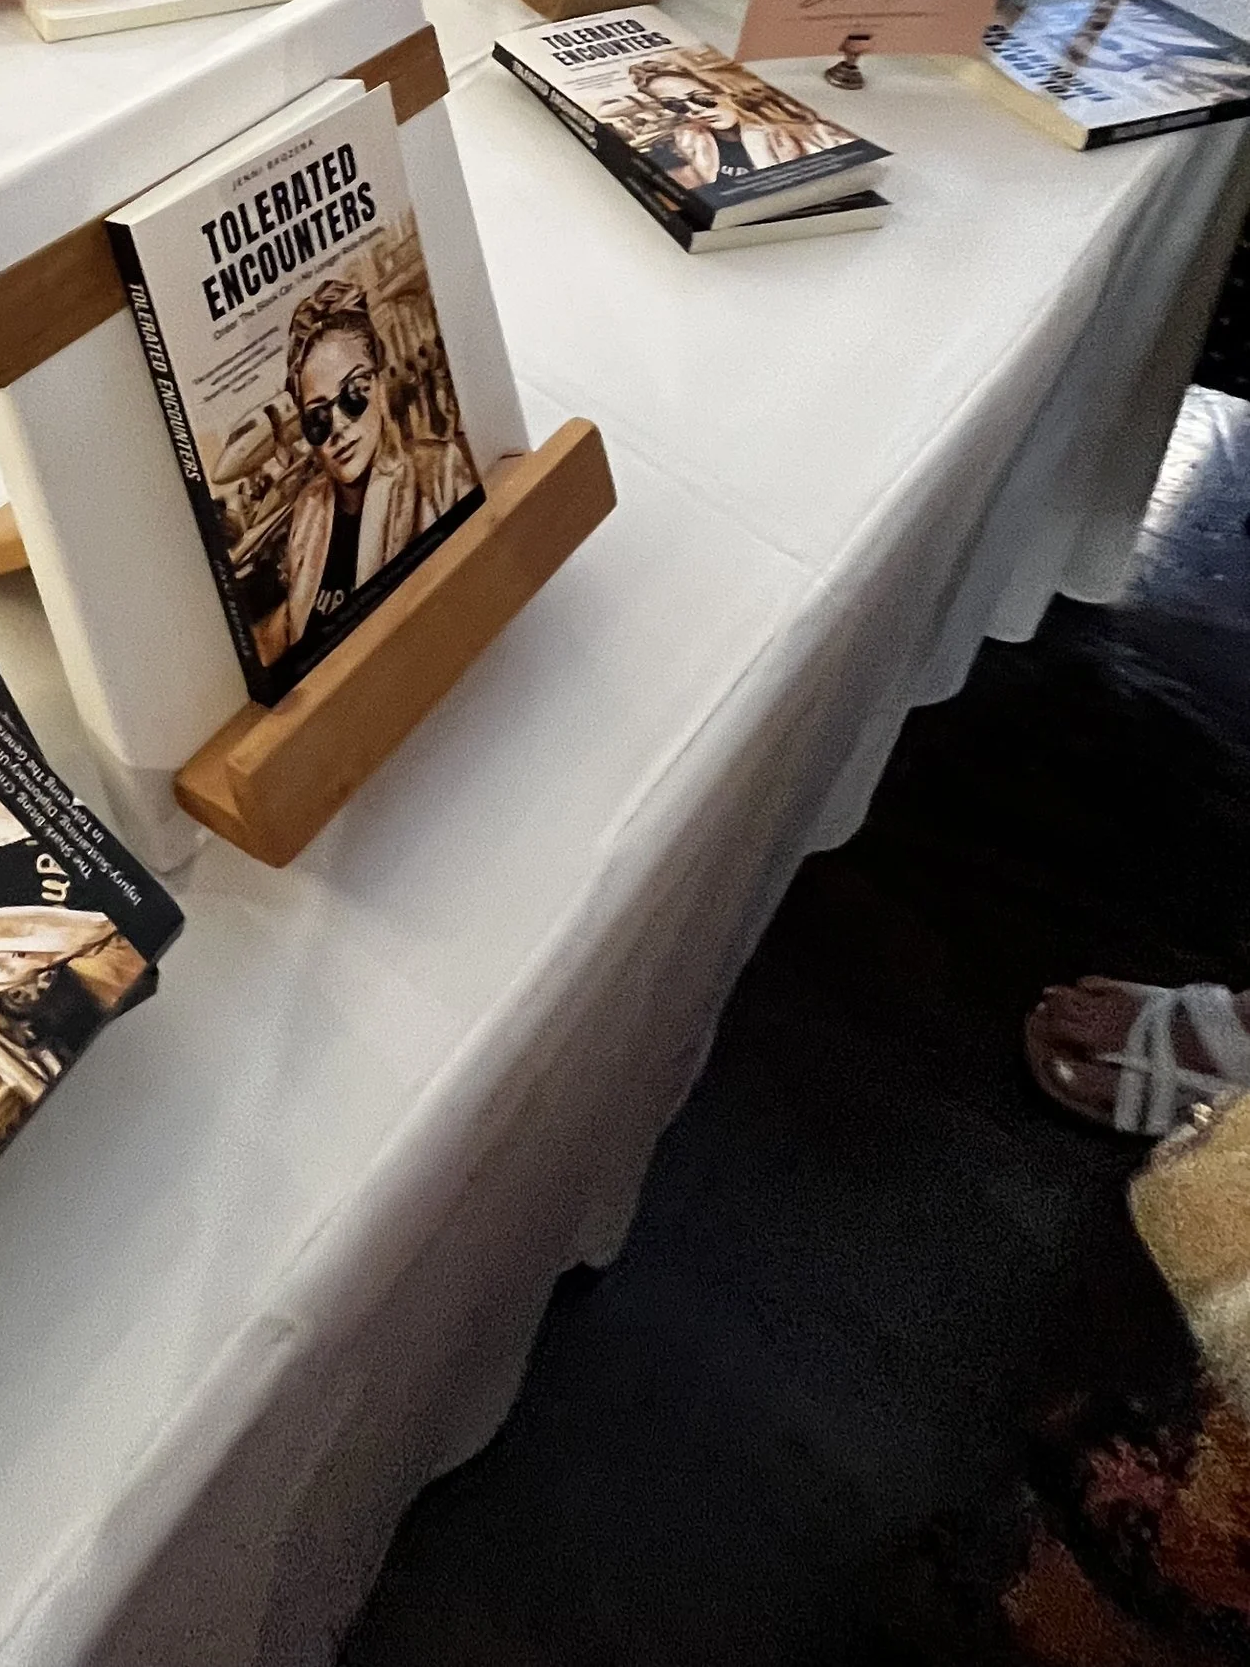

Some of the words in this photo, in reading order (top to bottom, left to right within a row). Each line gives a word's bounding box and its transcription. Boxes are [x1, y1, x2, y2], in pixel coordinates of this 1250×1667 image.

[540, 19, 646, 50] TOLERATED
[552, 32, 672, 66] ENCOUNTERS
[201, 141, 359, 264] TOLERATED
[200, 179, 378, 320] ENCOUNTERS
[128, 284, 168, 371] TOLERATED
[156, 378, 202, 480] ENCOUNTERS
[24, 757, 46, 781] The
[43, 774, 93, 832] Tolerating
[89, 827, 105, 843] In
[71, 853, 94, 879] The
